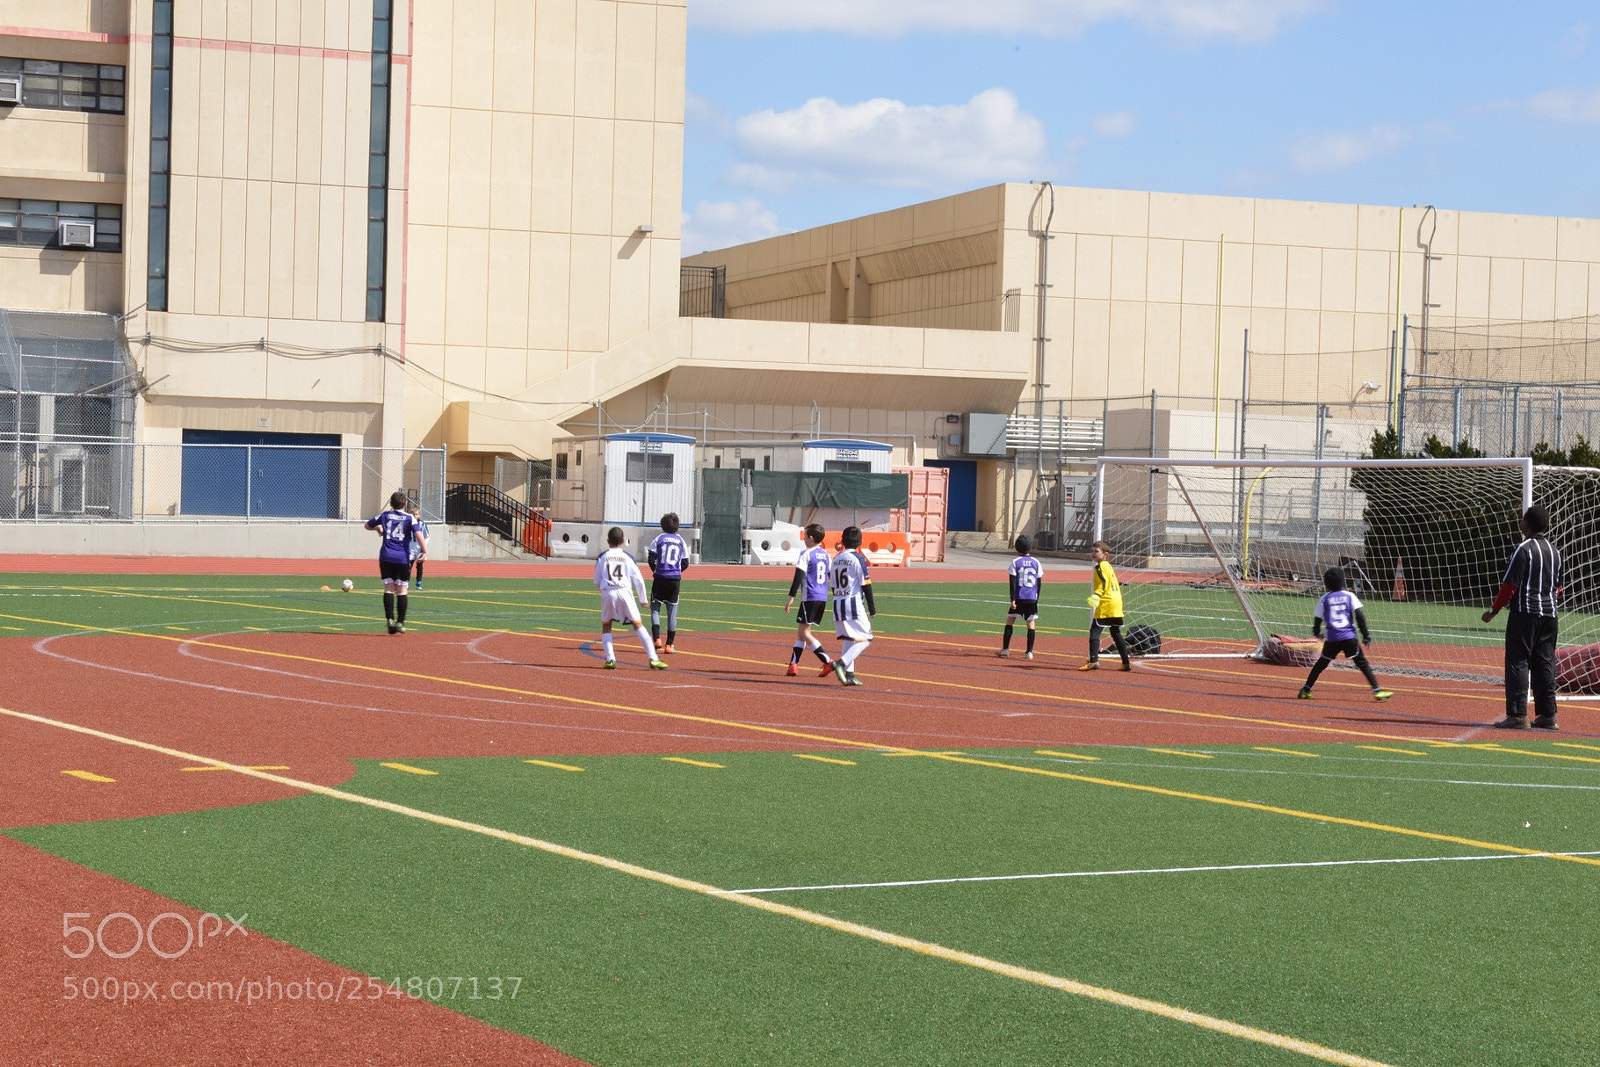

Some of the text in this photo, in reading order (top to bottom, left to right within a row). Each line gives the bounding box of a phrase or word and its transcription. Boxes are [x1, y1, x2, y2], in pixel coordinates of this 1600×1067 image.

[386, 519, 406, 541] 14
[660, 543, 680, 566] 10
[606, 564, 623, 581] 14
[816, 561, 826, 585] 8
[835, 567, 849, 589] 16
[1018, 567, 1037, 588] 16
[1330, 604, 1350, 628] 5
